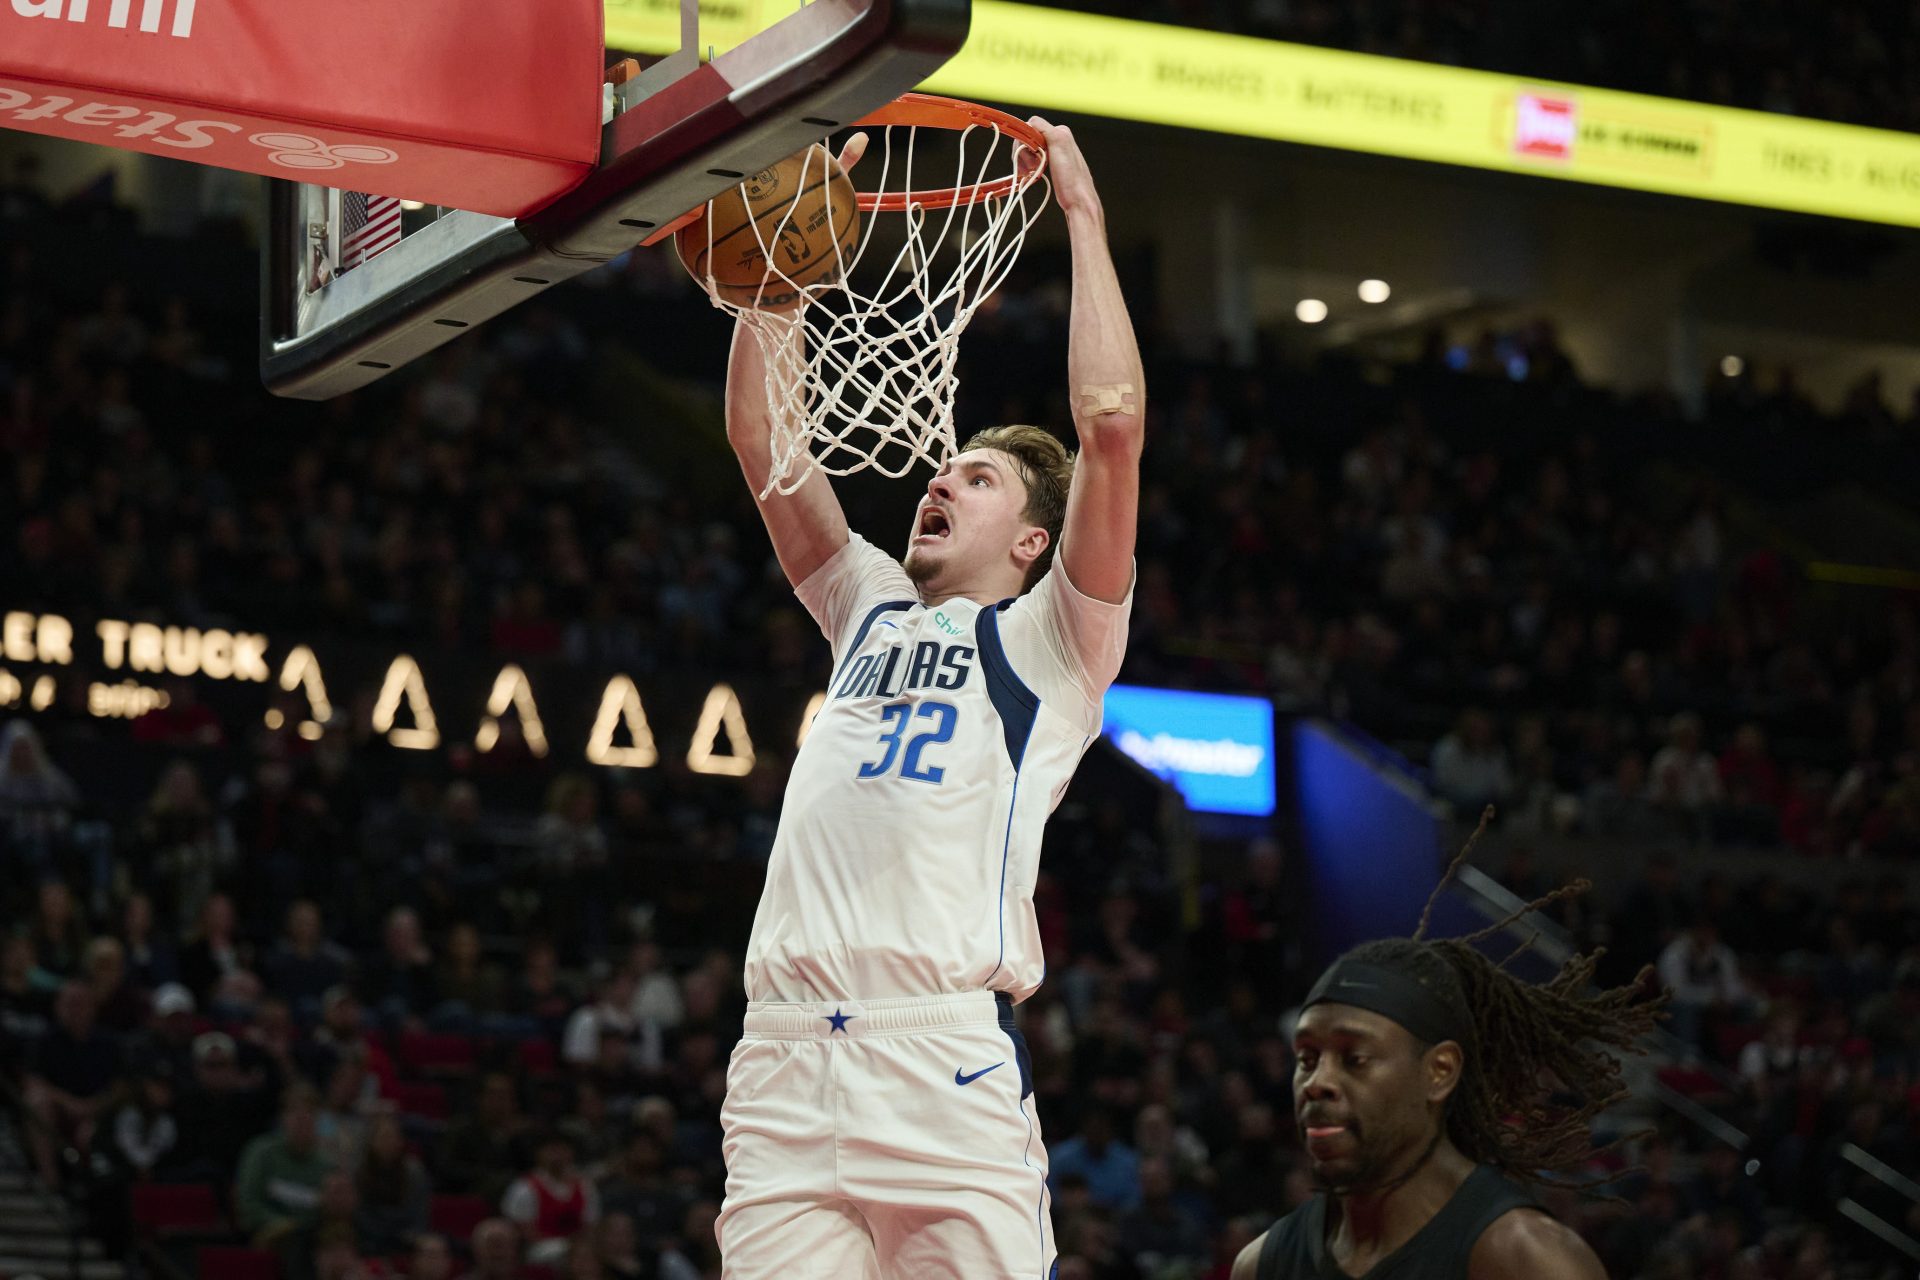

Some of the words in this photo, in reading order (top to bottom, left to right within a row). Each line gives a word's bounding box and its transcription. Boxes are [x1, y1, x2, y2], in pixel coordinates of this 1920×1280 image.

[0, 610, 73, 665] ER
[95, 618, 270, 683] TRUCK
[835, 641, 975, 700] DALAS
[856, 701, 958, 784] 32
